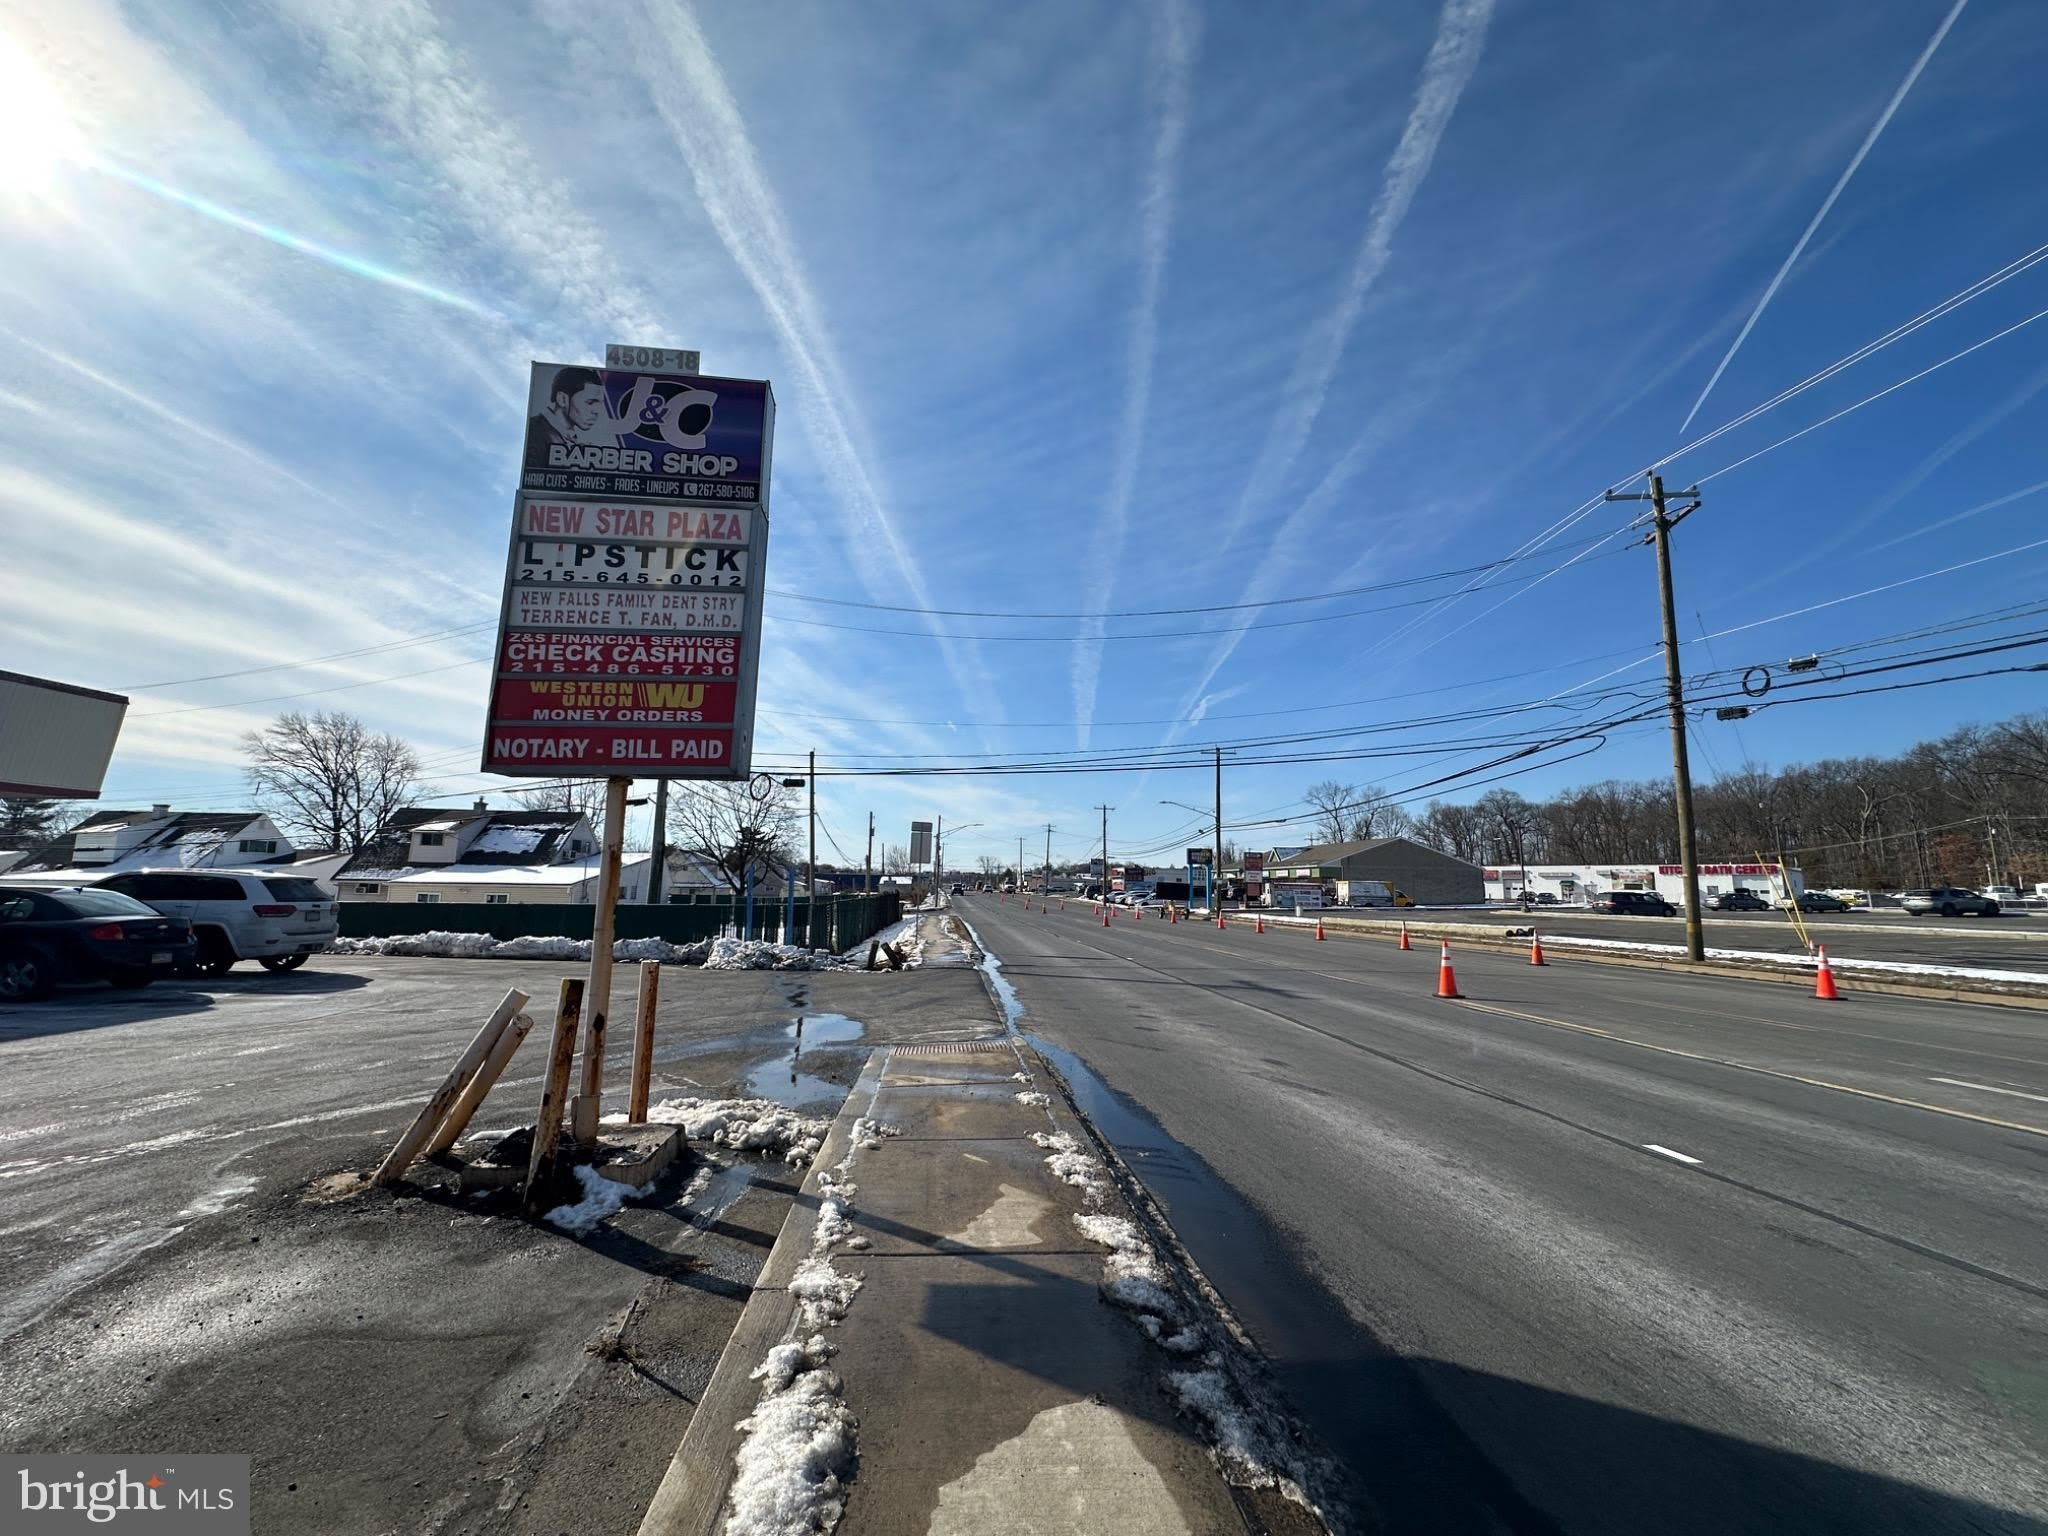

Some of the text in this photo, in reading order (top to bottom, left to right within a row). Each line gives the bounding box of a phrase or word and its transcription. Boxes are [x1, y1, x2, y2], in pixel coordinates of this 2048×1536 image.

[608, 346, 698, 370] 4508-18
[607, 376, 718, 450] J&C
[550, 444, 739, 477] BARBER SHOP
[524, 472, 545, 486] HAIR
[546, 474, 568, 488] CUTS
[573, 476, 606, 491] SHAVES
[614, 479, 640, 492] FADES
[646, 481, 680, 495] LINEUPS
[698, 483, 756, 498] 267-580-5106
[528, 504, 742, 541] NEW STAR PLAZA
[520, 569, 743, 588] 215-645-0012
[520, 591, 552, 607] NEW
[558, 592, 600, 608] FALLS
[607, 593, 656, 610] FAMILY
[520, 609, 738, 629] TERRENCE T. FAN, D.M.D.
[507, 632, 736, 648] Z&S FINANCIAL SERVICES
[507, 643, 736, 664] CHECK CASHING
[510, 662, 735, 676] 215-486-5730
[530, 681, 706, 710] WESTERN WU
[561, 694, 633, 707] UNION
[532, 709, 704, 722] MONEY ORDERS
[492, 738, 591, 759] NOTARY
[611, 739, 664, 760] BILL
[671, 739, 724, 760] PAID
[1659, 865, 1778, 875] KITCN BATH CENTER
